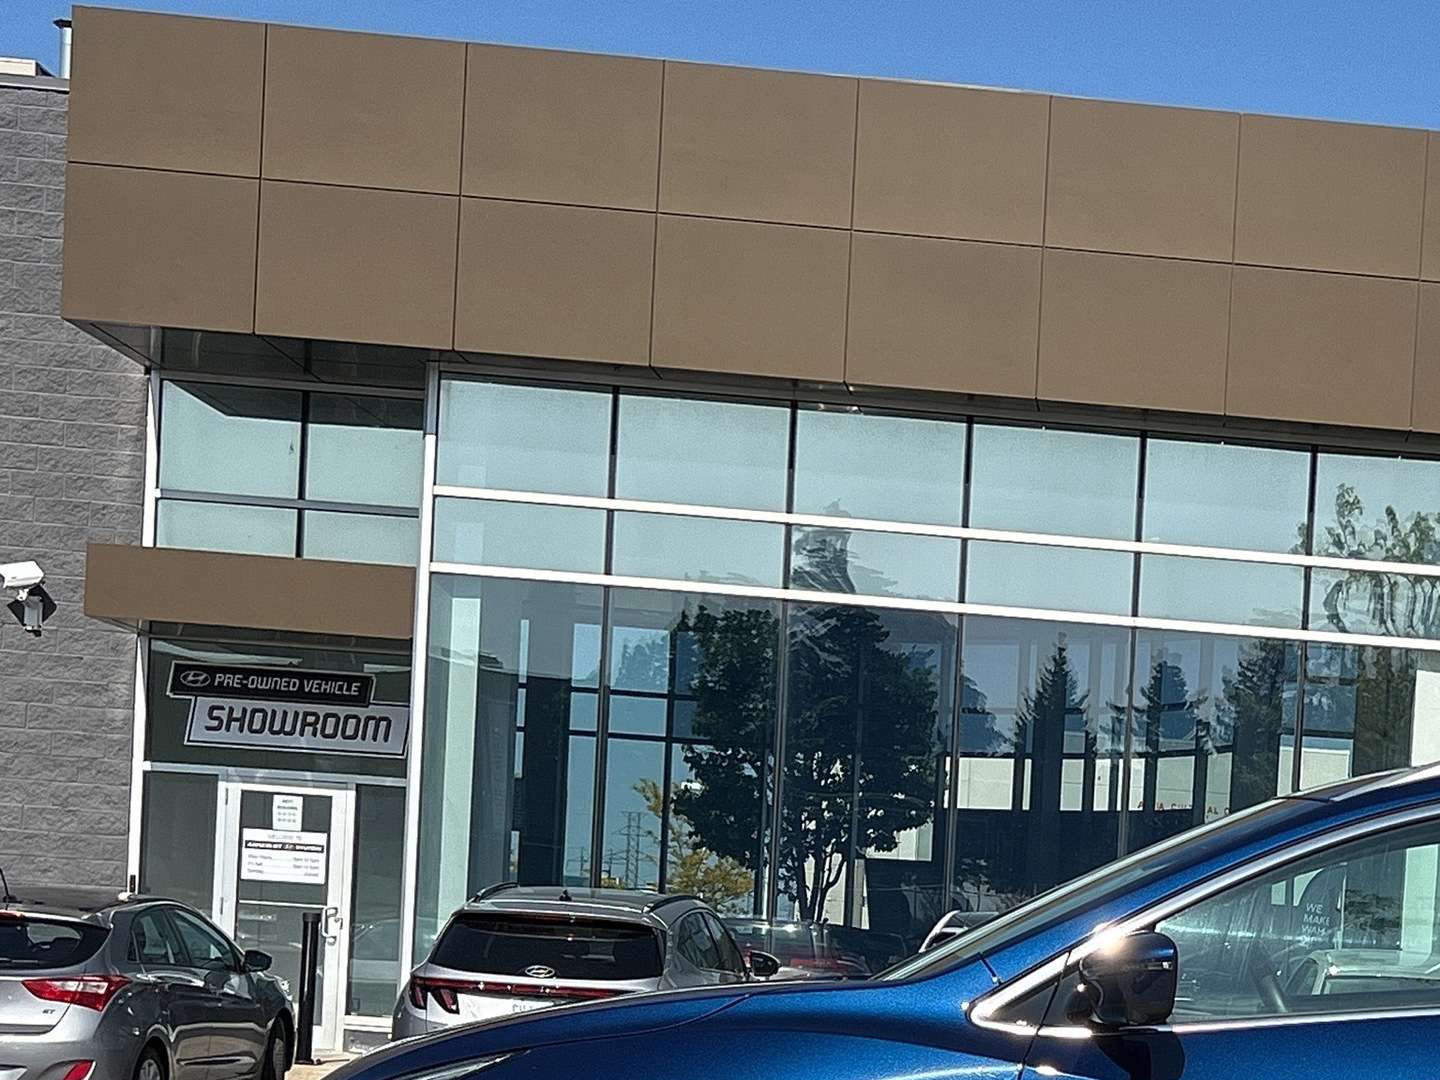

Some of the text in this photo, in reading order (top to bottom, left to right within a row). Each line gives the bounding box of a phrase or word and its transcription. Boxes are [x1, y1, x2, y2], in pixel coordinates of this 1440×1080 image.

[214, 672, 361, 696] PRE-OWNED VEHICLE
[204, 704, 392, 743] SHOWROOM
[1306, 902, 1323, 914] WE
